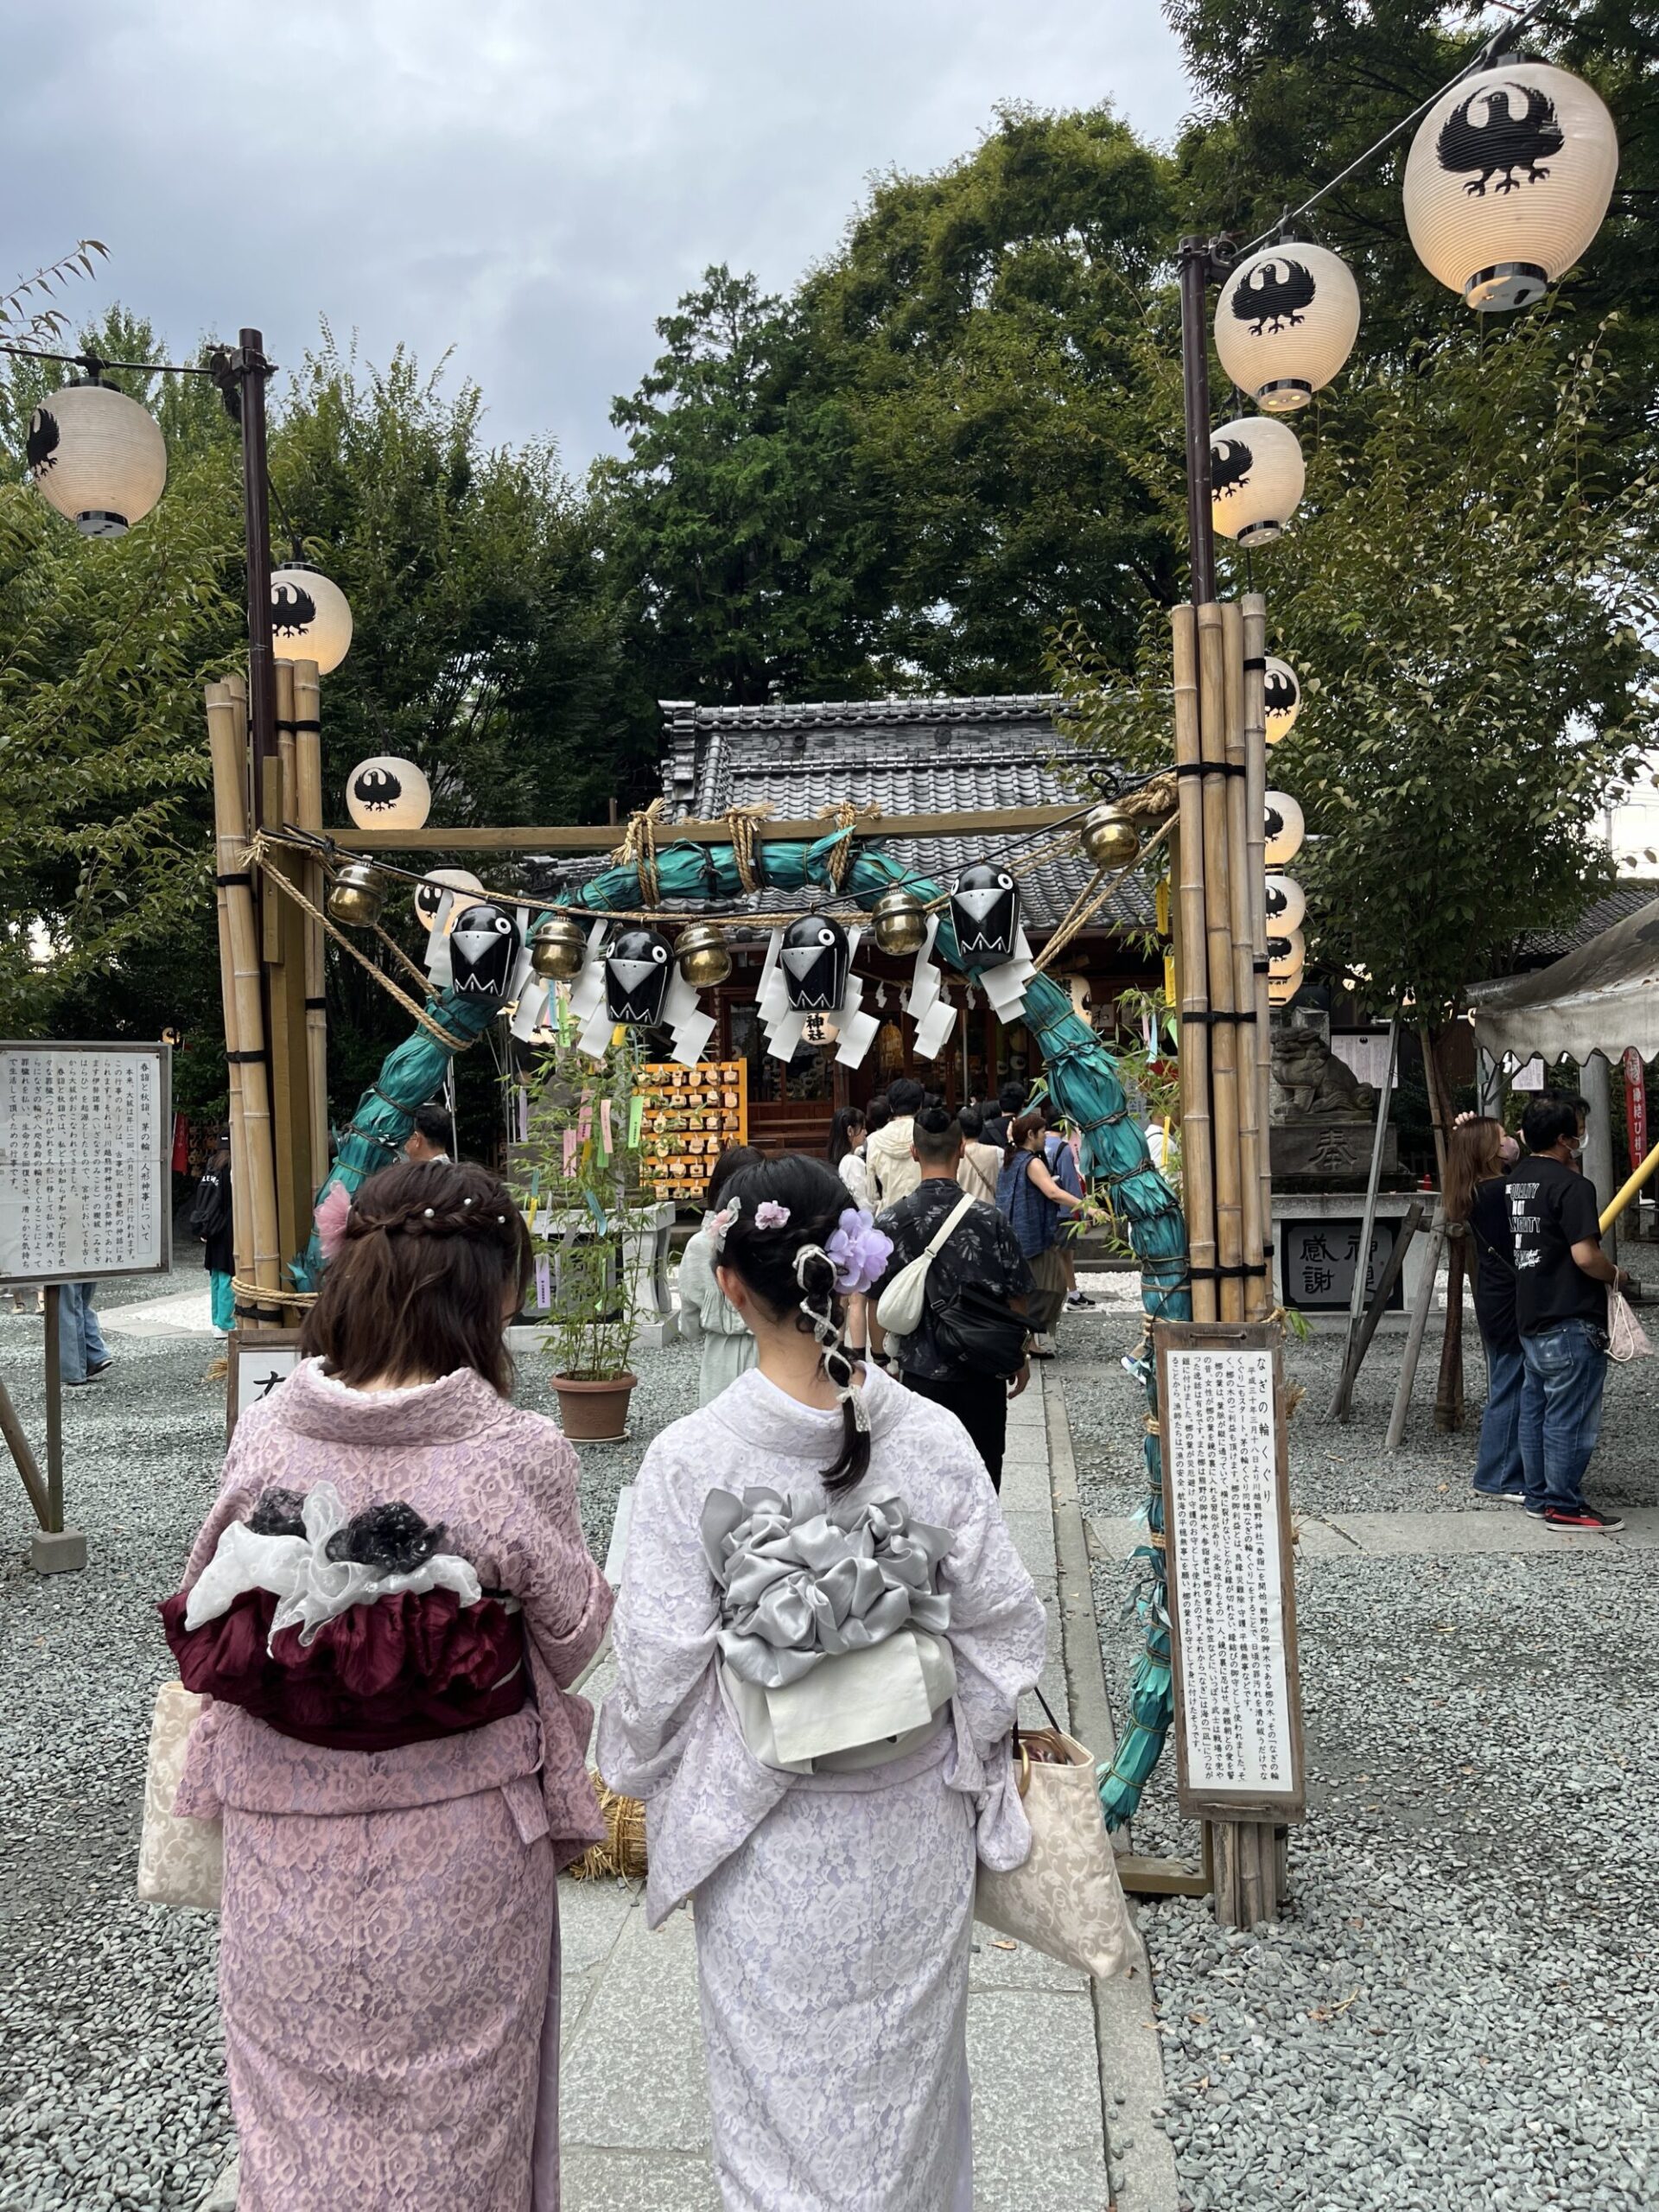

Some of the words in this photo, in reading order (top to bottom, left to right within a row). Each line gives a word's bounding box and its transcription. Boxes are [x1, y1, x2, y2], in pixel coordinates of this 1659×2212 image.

[1308, 1127, 1358, 1172] 奉
[1300, 1233, 1340, 1294] 感謝
[1256, 1357, 1271, 1503] なぎの輪くぐり
